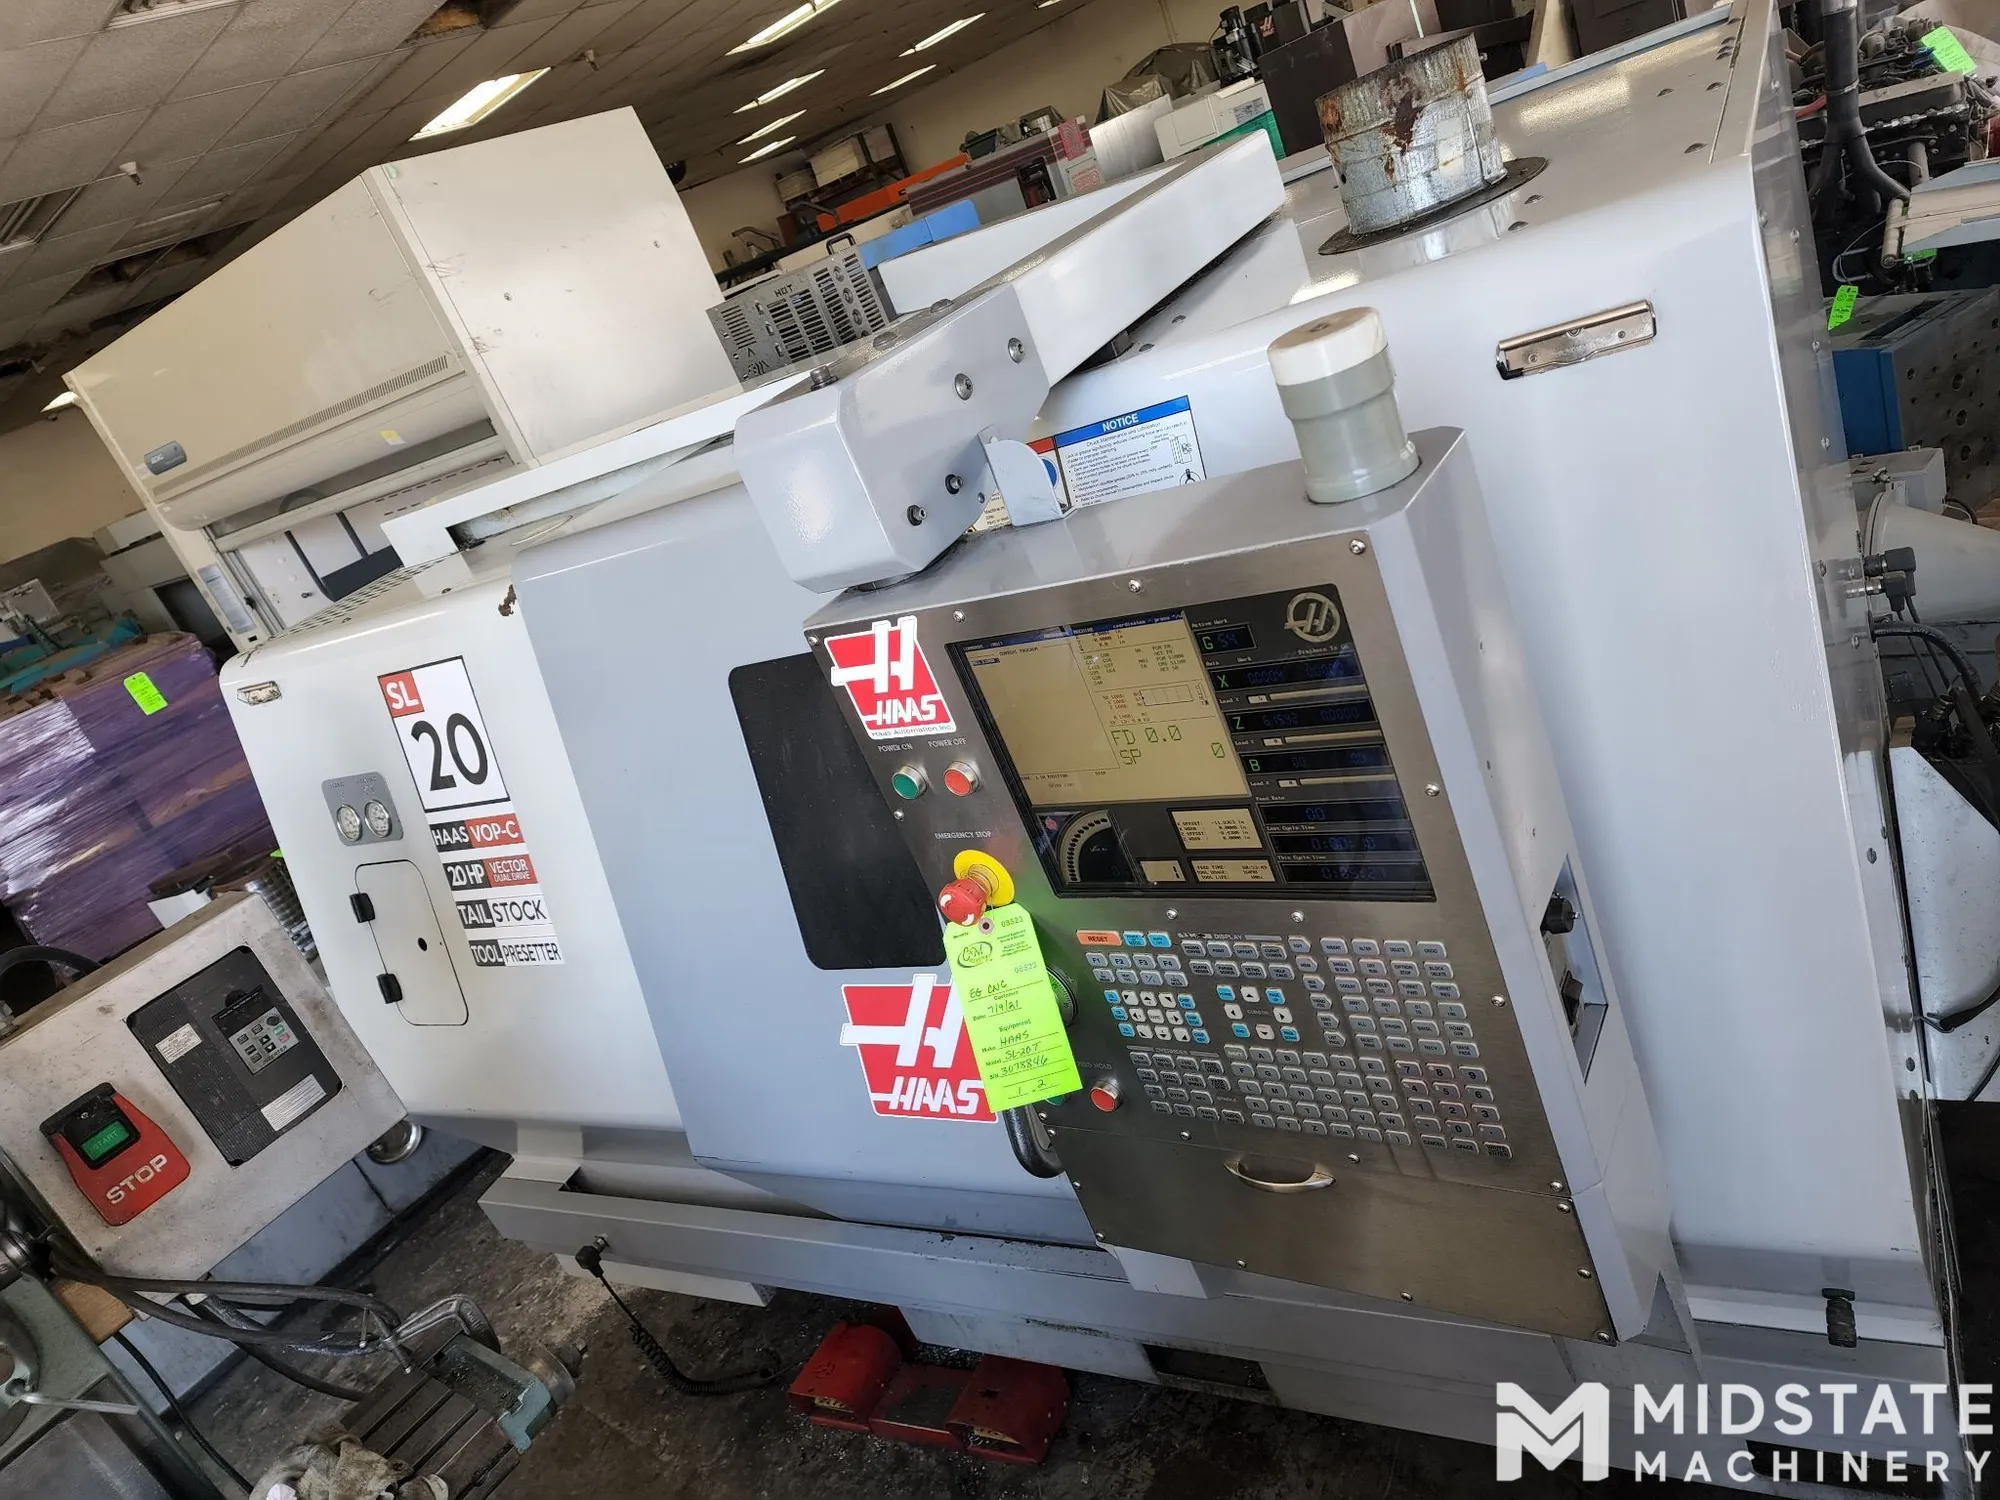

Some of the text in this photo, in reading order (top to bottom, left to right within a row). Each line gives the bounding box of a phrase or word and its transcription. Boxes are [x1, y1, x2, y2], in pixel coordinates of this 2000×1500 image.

[774, 284, 793, 298] HOT
[1102, 413, 1139, 432] NOTICE
[1202, 636, 1214, 650] G
[1217, 674, 1229, 689] X
[386, 680, 419, 710] SL
[865, 694, 942, 725] HAAS
[1233, 716, 1244, 730] Z
[894, 726, 938, 735] Automation
[1111, 724, 1182, 746] FD 0.0
[878, 744, 900, 752] POWER
[928, 738, 967, 748] POWER OFF
[410, 712, 488, 792] 20
[1119, 741, 1226, 766] SP 0
[1249, 760, 1261, 772] B
[431, 819, 520, 847] HAAS VOP-C
[934, 830, 992, 840] EMERGENCY STOP
[488, 860, 529, 874] VECTOR
[446, 864, 485, 887] 20 HP
[493, 872, 530, 882] DUAL DRIVE
[457, 899, 547, 926] TAIL STOCK
[471, 942, 562, 965] TOOL PRESETTER
[988, 980, 1008, 994] CNC
[994, 990, 1018, 1001] Customer
[988, 1000, 1020, 1014] 7/9/21
[998, 1018, 1032, 1032] Equipment
[1000, 1032, 1030, 1048] HAAS
[1094, 1062, 1112, 1070] HOLD
[1404, 1066, 1411, 1074] 7
[1436, 1068, 1444, 1077] 8
[1468, 1072, 1476, 1080] 9
[1037, 1079, 1046, 1089] 2
[873, 1076, 984, 1115] HAAS
[1442, 1088, 1450, 1096] 5
[1475, 1090, 1482, 1098] 6
[1450, 1107, 1456, 1115] 2
[1482, 1110, 1489, 1118] 3
[1454, 1125, 1462, 1133] 0
[92, 1130, 118, 1150] START
[106, 1154, 168, 1205] STOP
